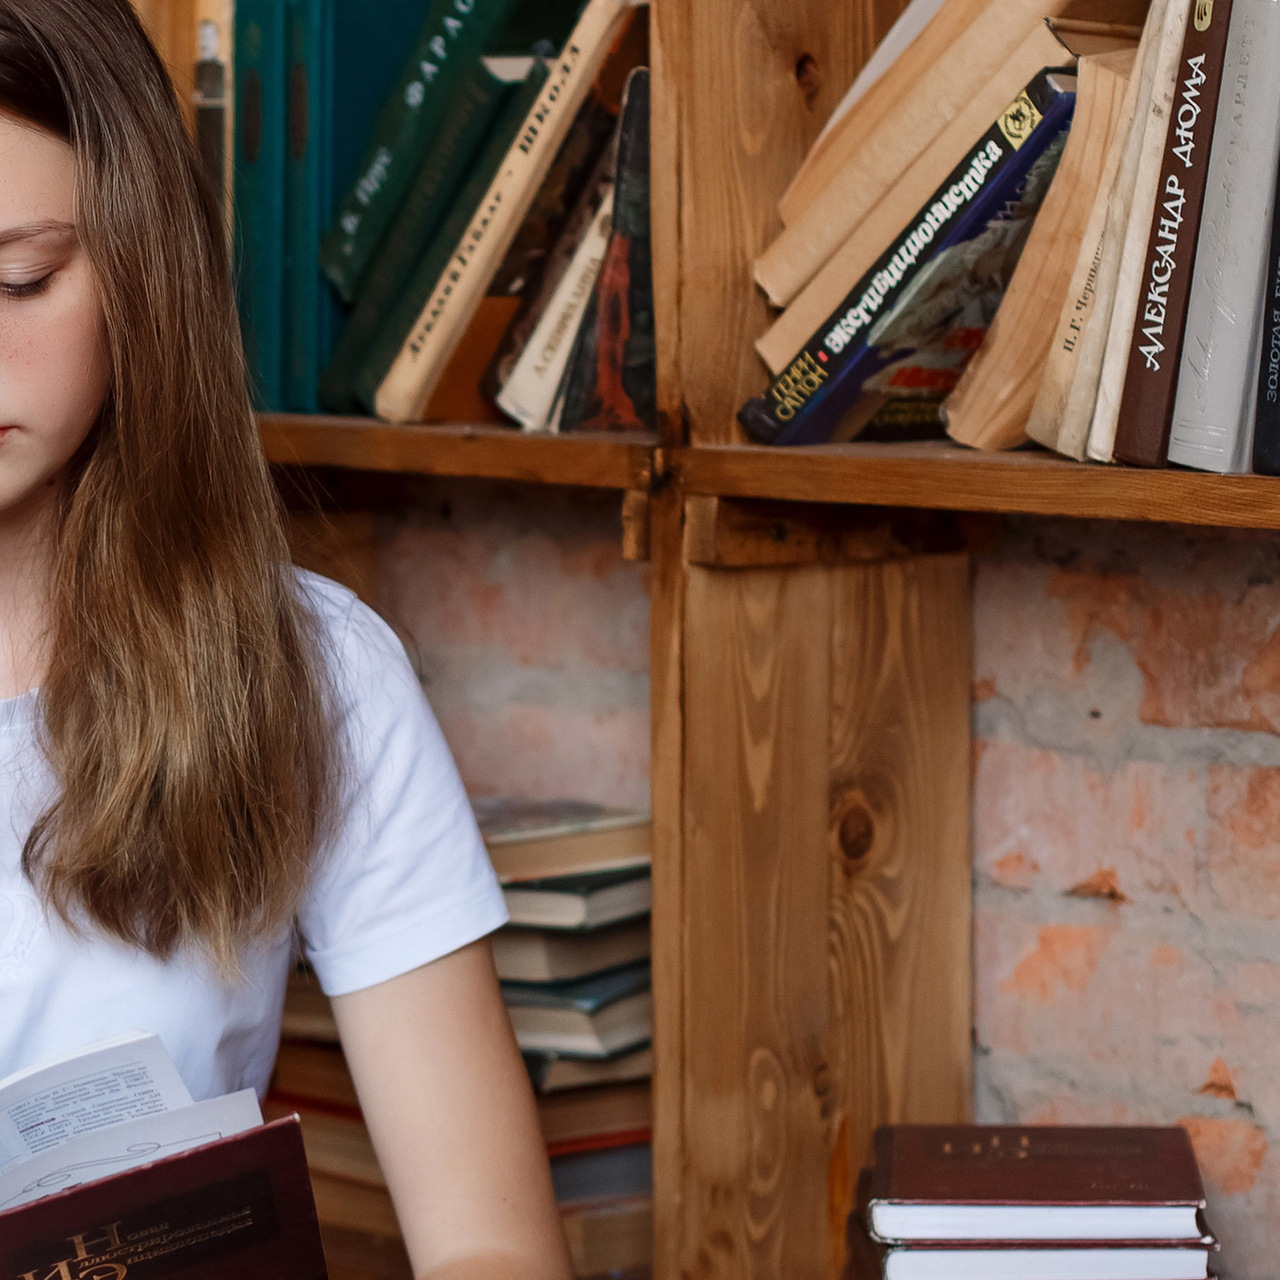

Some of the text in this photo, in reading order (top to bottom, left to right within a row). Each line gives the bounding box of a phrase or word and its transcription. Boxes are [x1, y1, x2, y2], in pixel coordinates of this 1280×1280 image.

[1131, 174, 1188, 372] АЛЕКСАНДР
[1172, 53, 1207, 168] ДЮМА
[1070, 318, 1083, 332] Г.
[772, 350, 816, 402] ГЕНРИ
